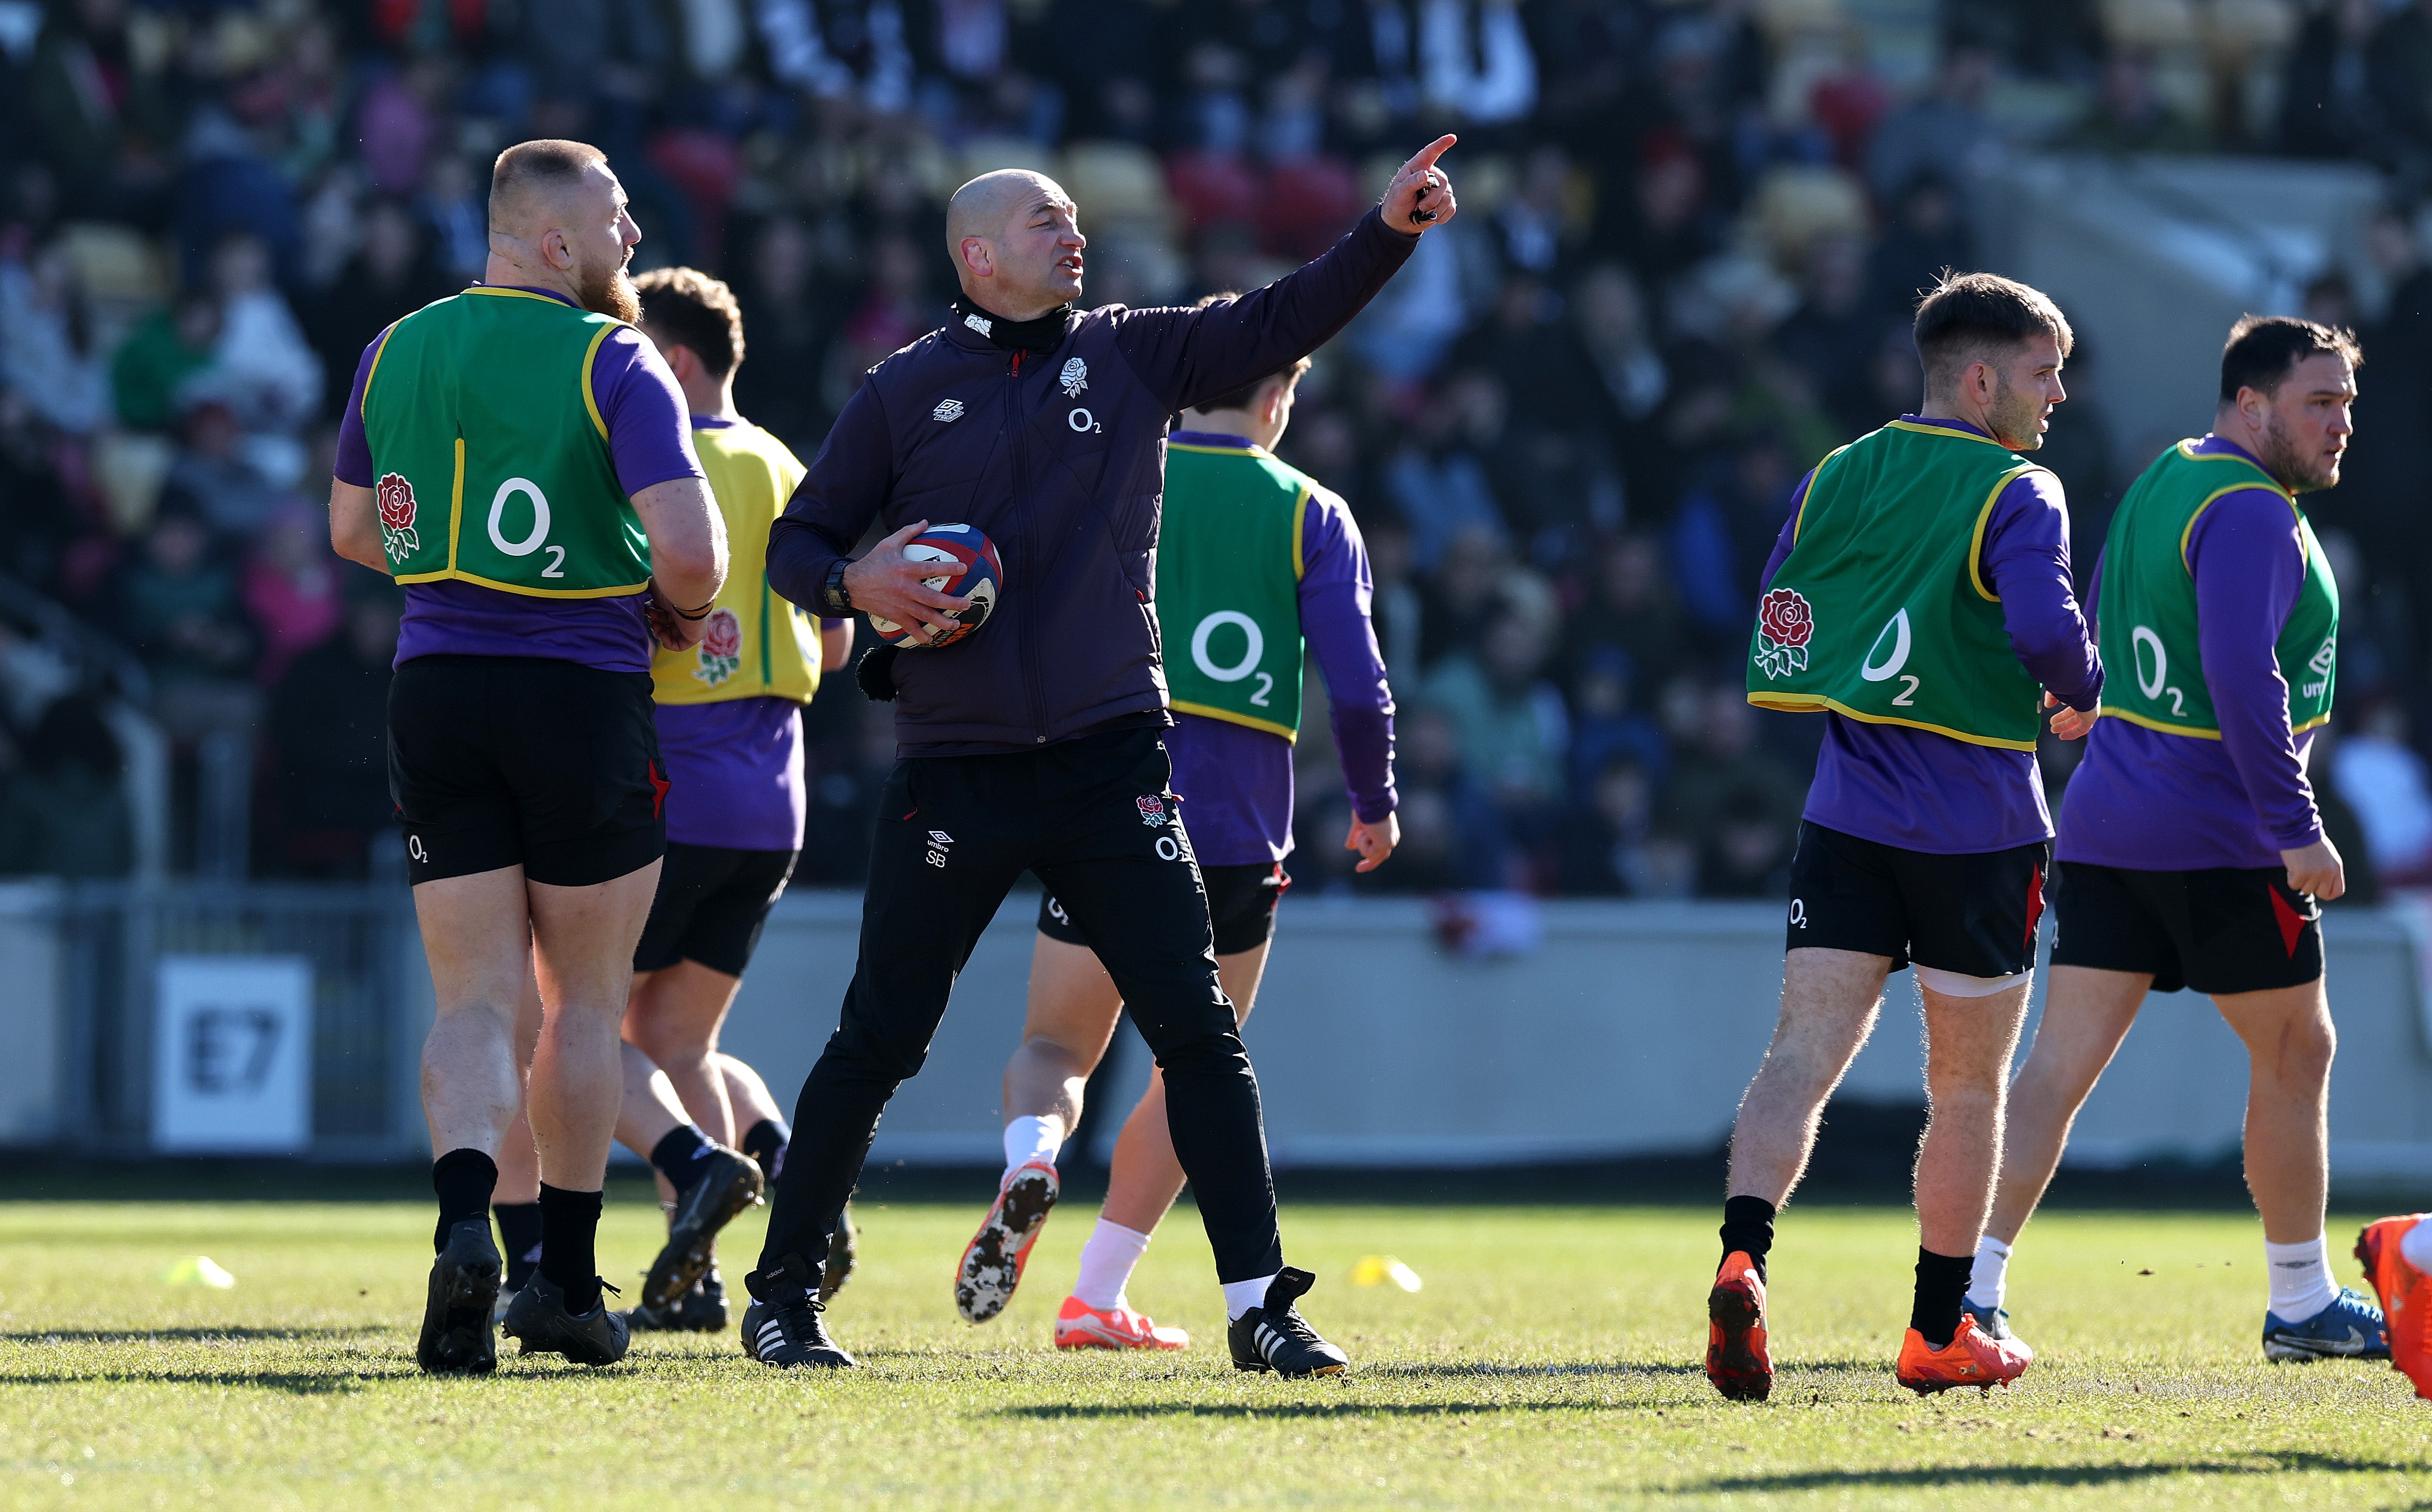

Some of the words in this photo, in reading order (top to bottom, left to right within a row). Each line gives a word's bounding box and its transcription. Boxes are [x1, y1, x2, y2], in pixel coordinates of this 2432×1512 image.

[937, 411, 961, 421] TRAINING
[1069, 408, 1102, 434] O2
[487, 477, 565, 578] O2
[1191, 610, 1273, 707] O2
[1861, 608, 1920, 706] O2
[2132, 625, 2188, 717] O2
[409, 835, 428, 863] O2
[926, 850, 946, 868] SB
[928, 840, 949, 852] umbro
[1790, 899, 1807, 929] O2
[189, 1008, 284, 1095] E7
